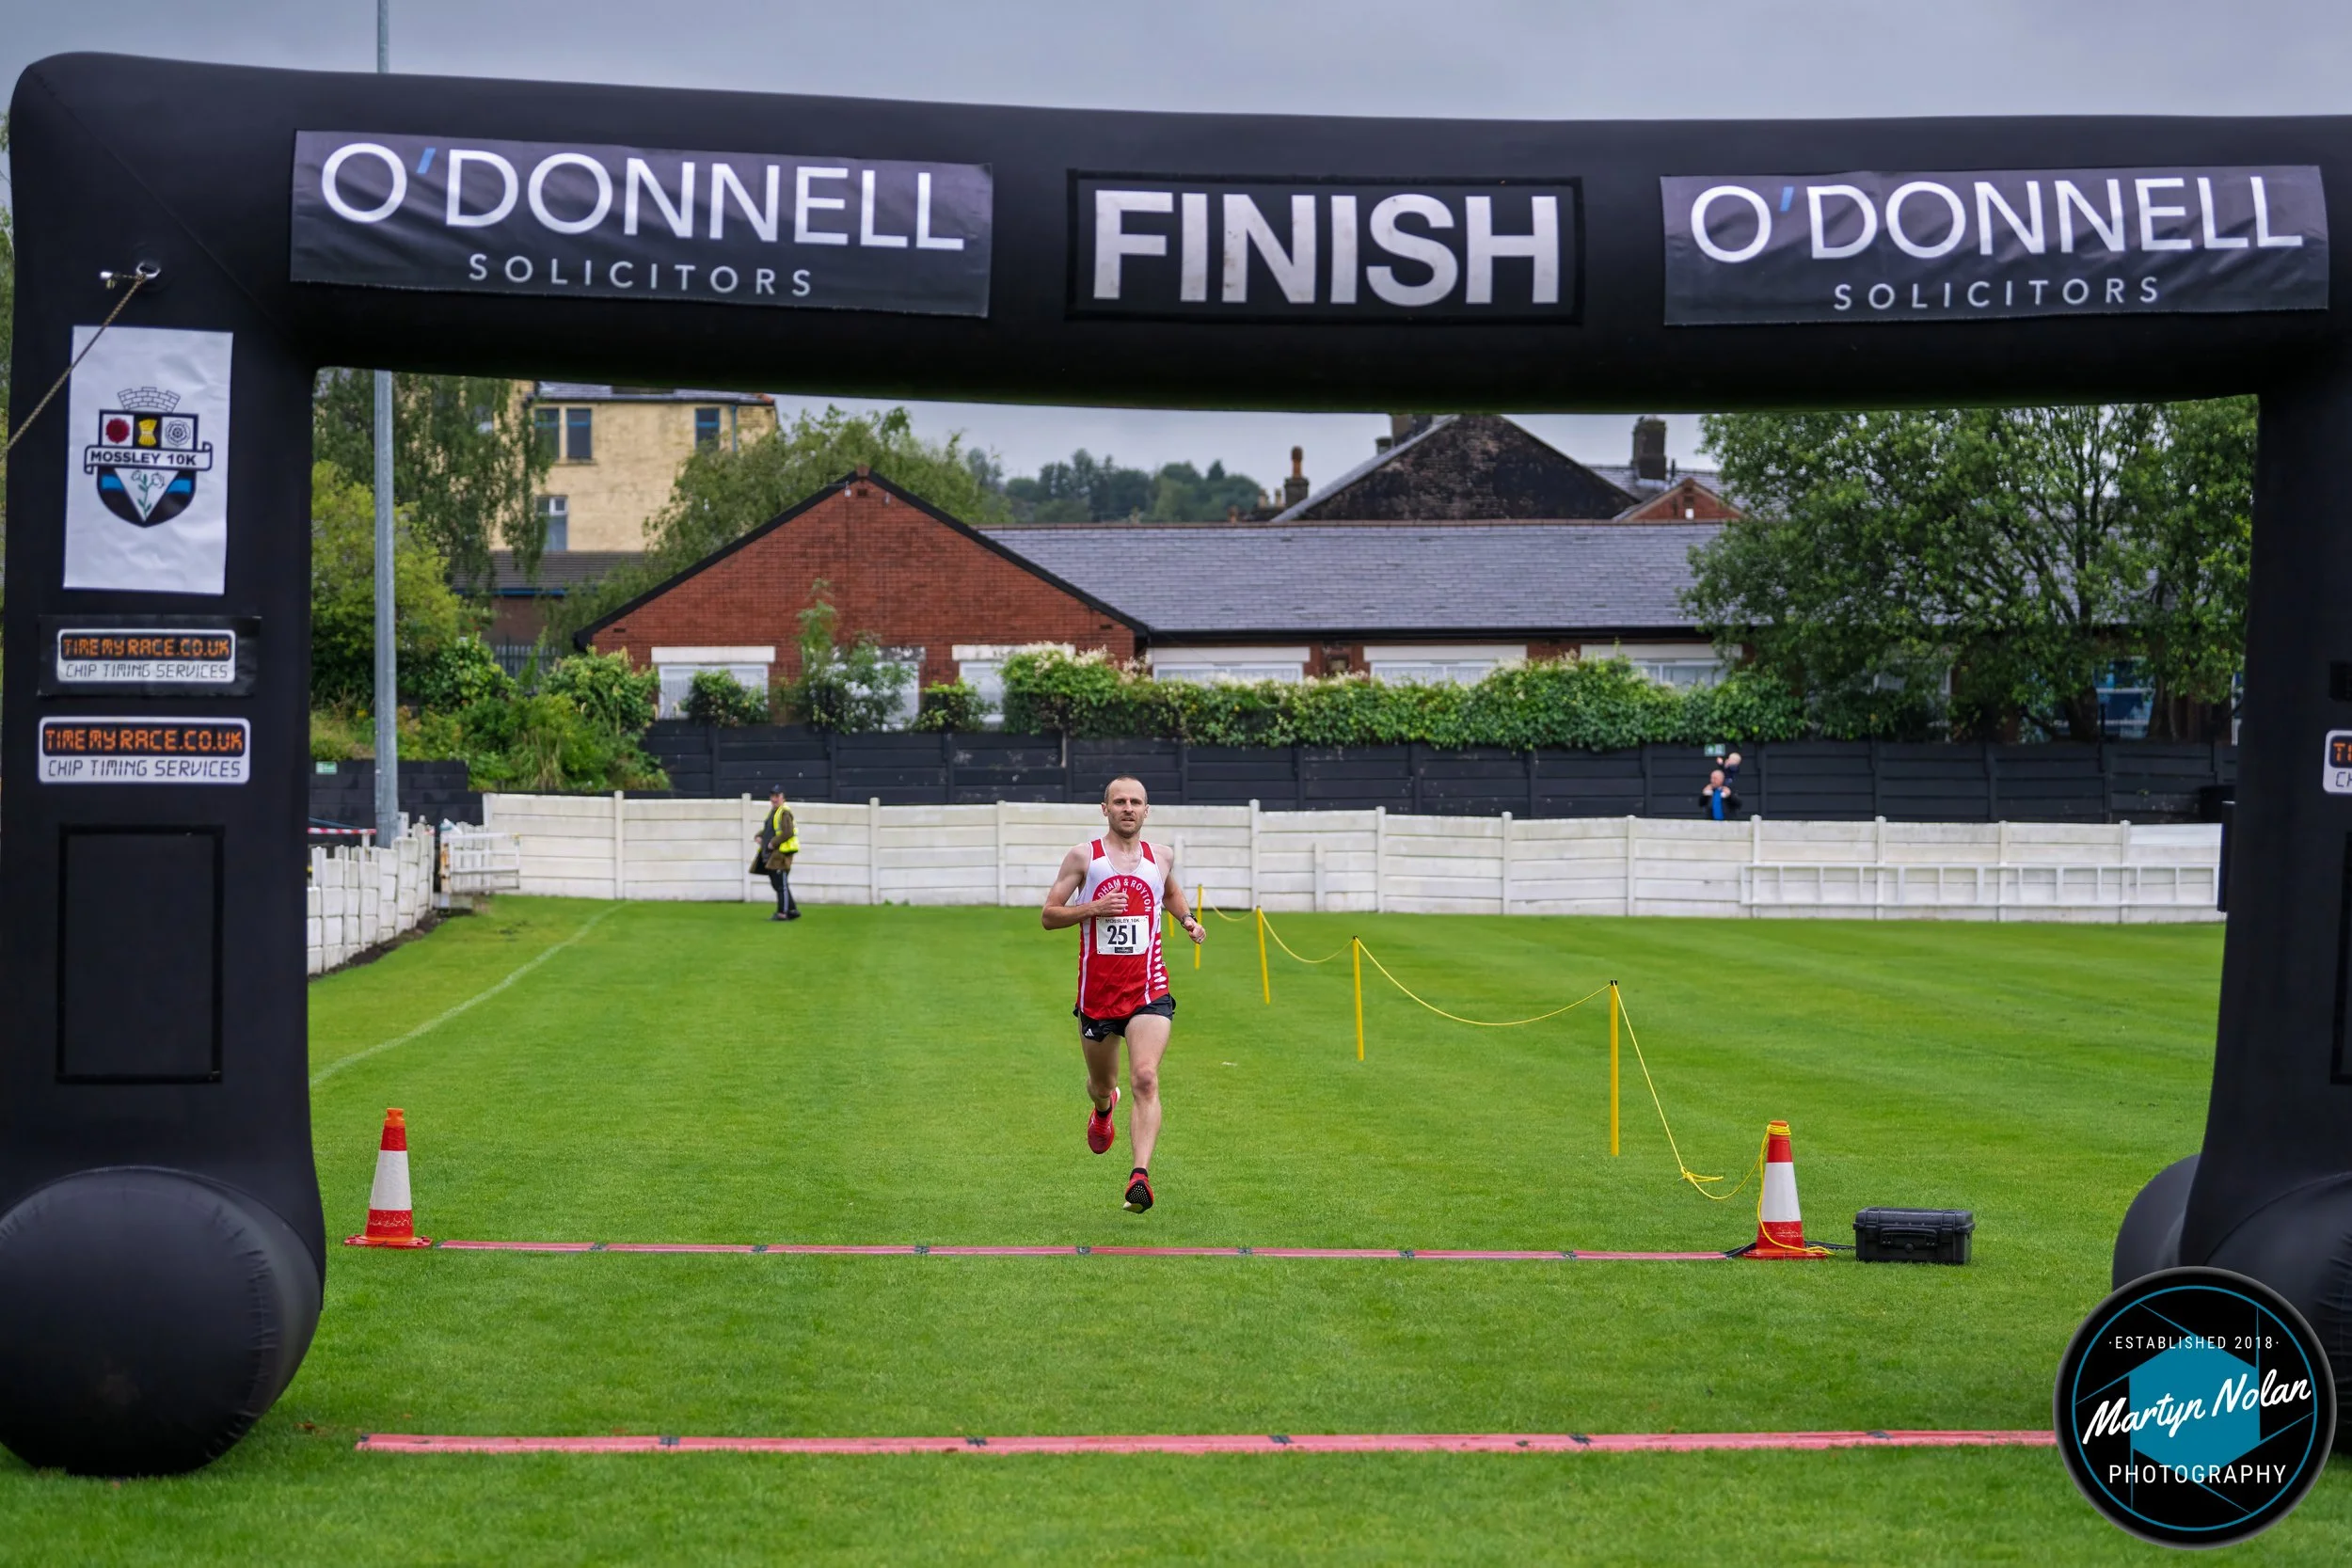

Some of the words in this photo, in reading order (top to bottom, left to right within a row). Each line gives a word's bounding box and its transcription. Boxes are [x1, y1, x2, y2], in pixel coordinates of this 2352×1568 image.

[321, 142, 964, 250] O'DONNELL
[1690, 176, 2303, 263] O'DONNELL
[1094, 189, 1559, 307] FINISH
[469, 253, 812, 297] SOLICITORS
[1834, 277, 2159, 310] SOLICITORS
[90, 451, 161, 465] MOSSLEY
[167, 453, 197, 467] 10K
[66, 663, 98, 678] CHIP
[103, 663, 151, 679] TIMING
[156, 663, 229, 679] SERVICES
[48, 759, 84, 778] CHIP
[90, 759, 148, 778] TIMING
[154, 759, 241, 778] SERVICES
[1097, 879, 1120, 898] DHAM
[1131, 879, 1152, 911] ROYTON
[1106, 925, 1136, 945] 251
